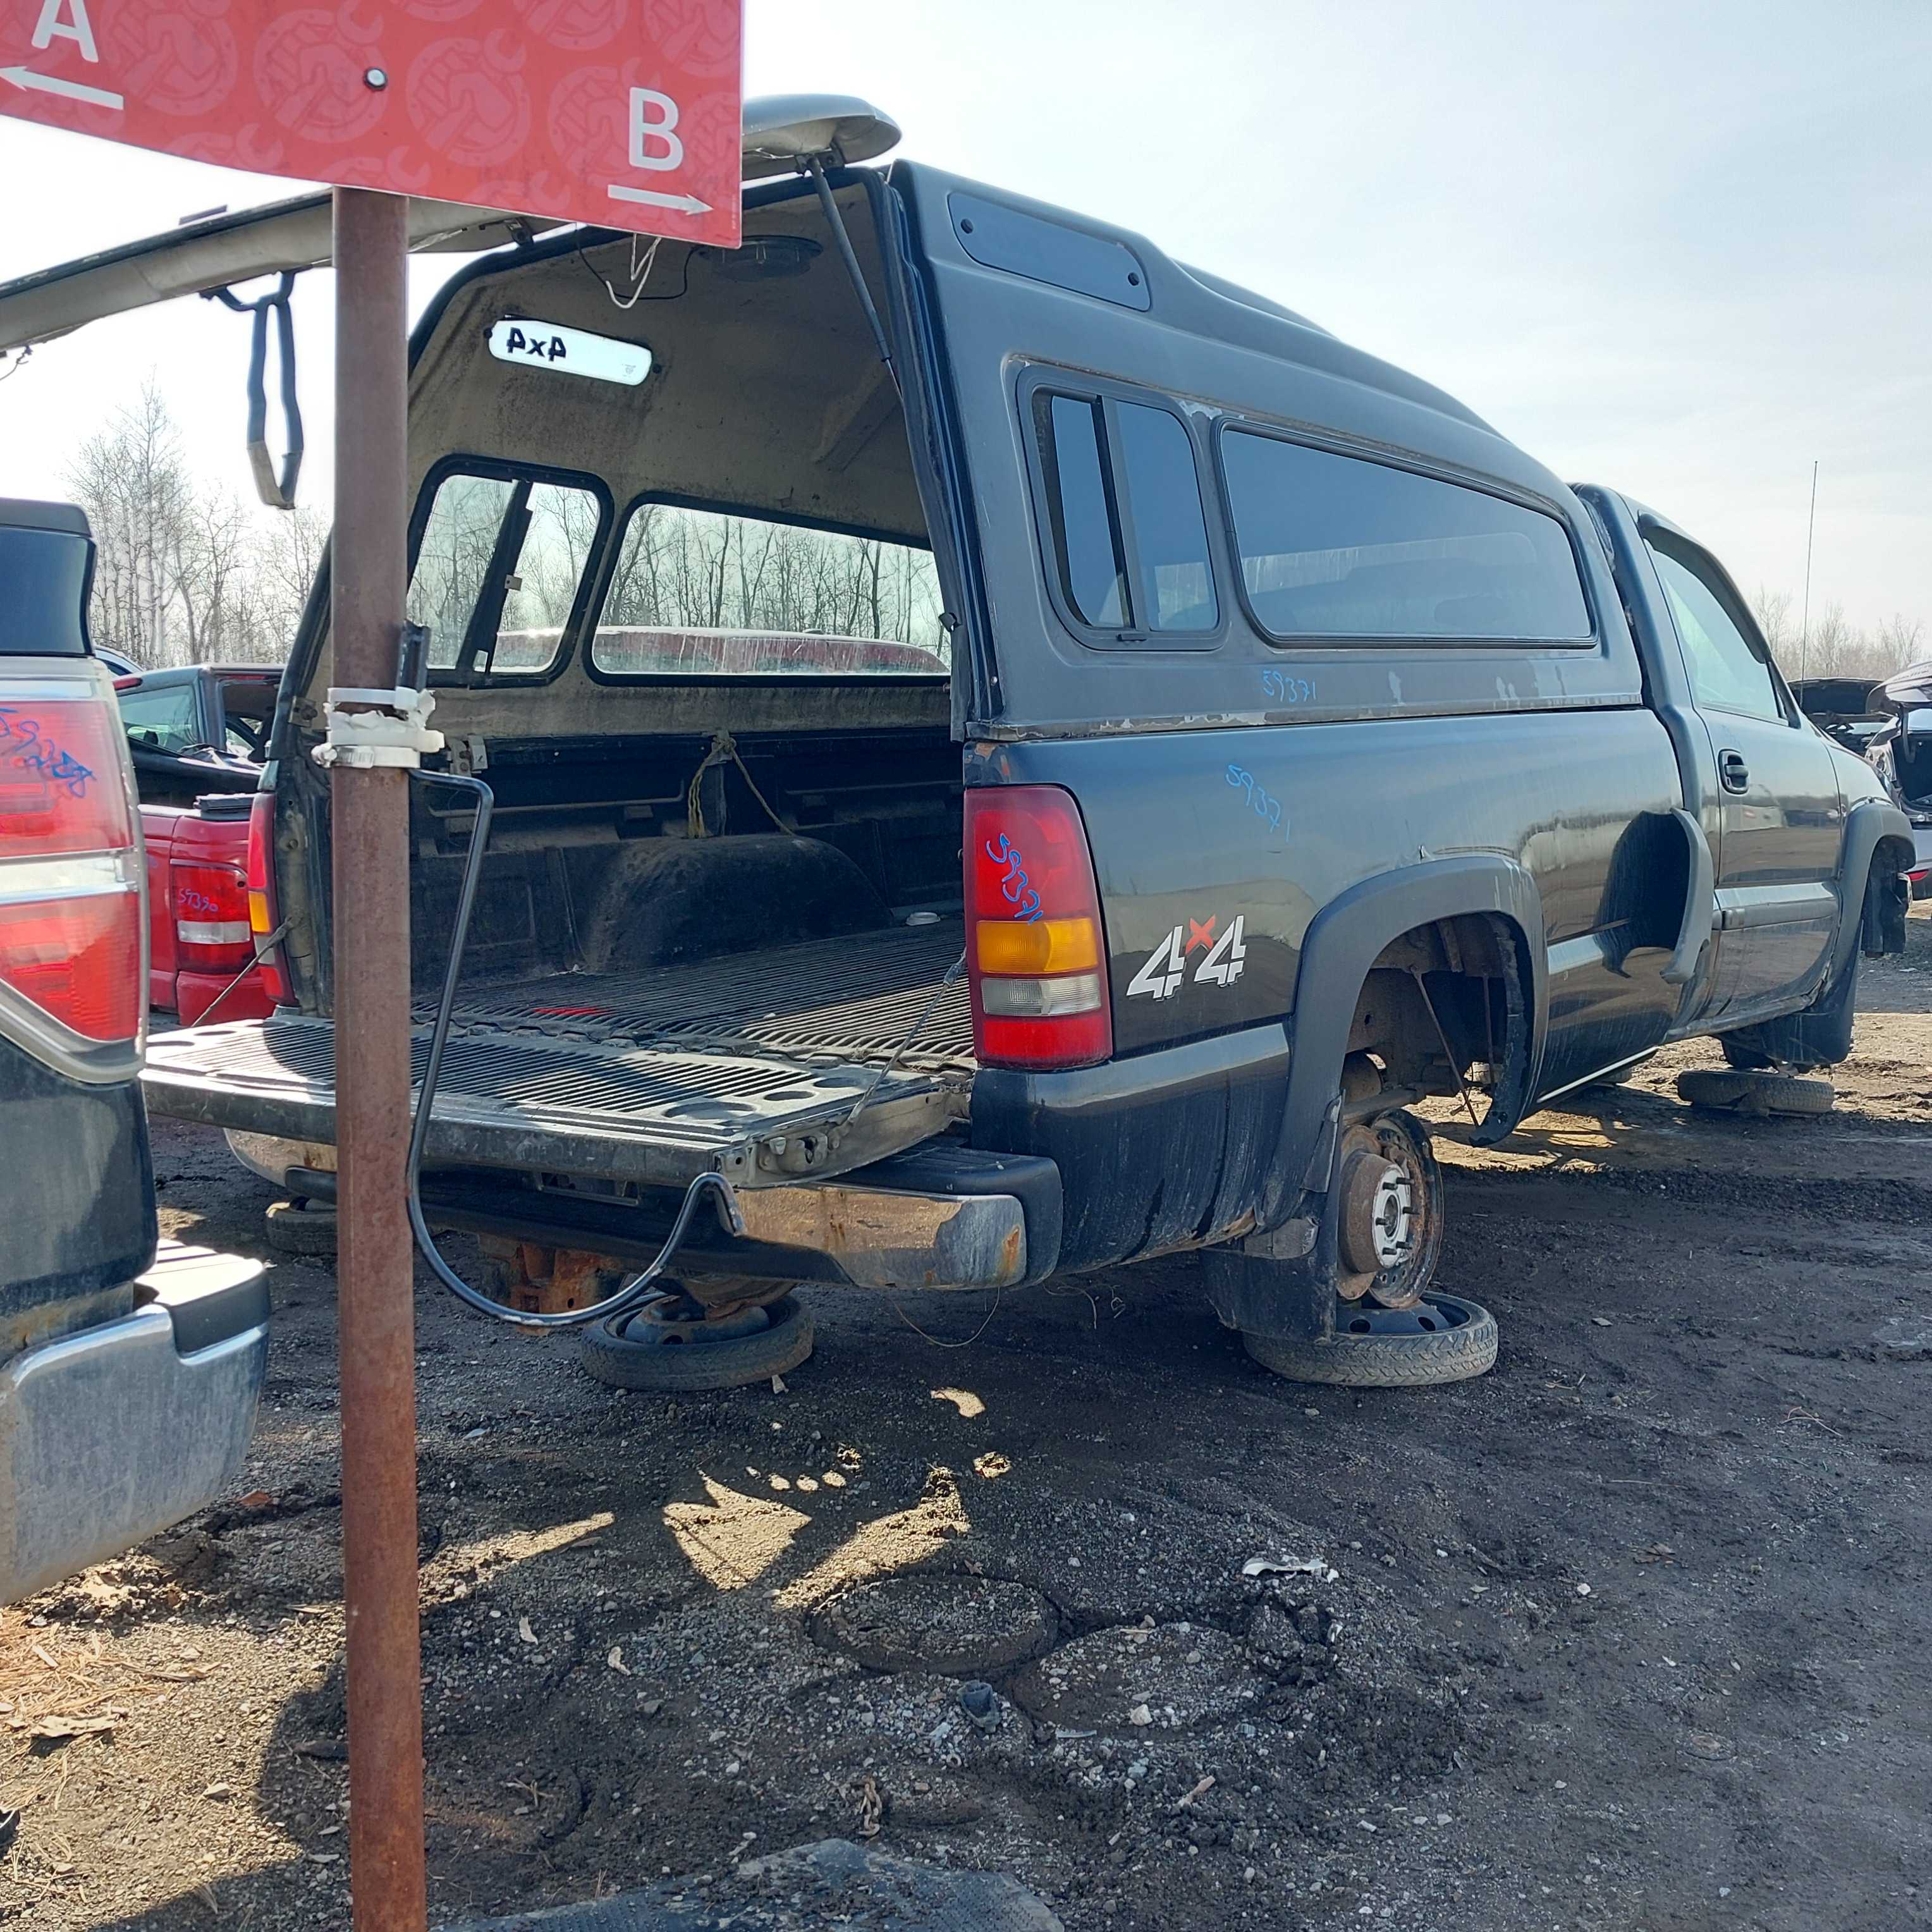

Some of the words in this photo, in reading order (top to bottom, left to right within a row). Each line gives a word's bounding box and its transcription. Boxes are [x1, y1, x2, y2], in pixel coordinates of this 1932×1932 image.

[32, 0, 99, 63] A
[629, 87, 683, 171] B
[1263, 669, 1316, 702] 59371
[1226, 764, 1291, 843] 59371
[986, 832, 1044, 926] 59371
